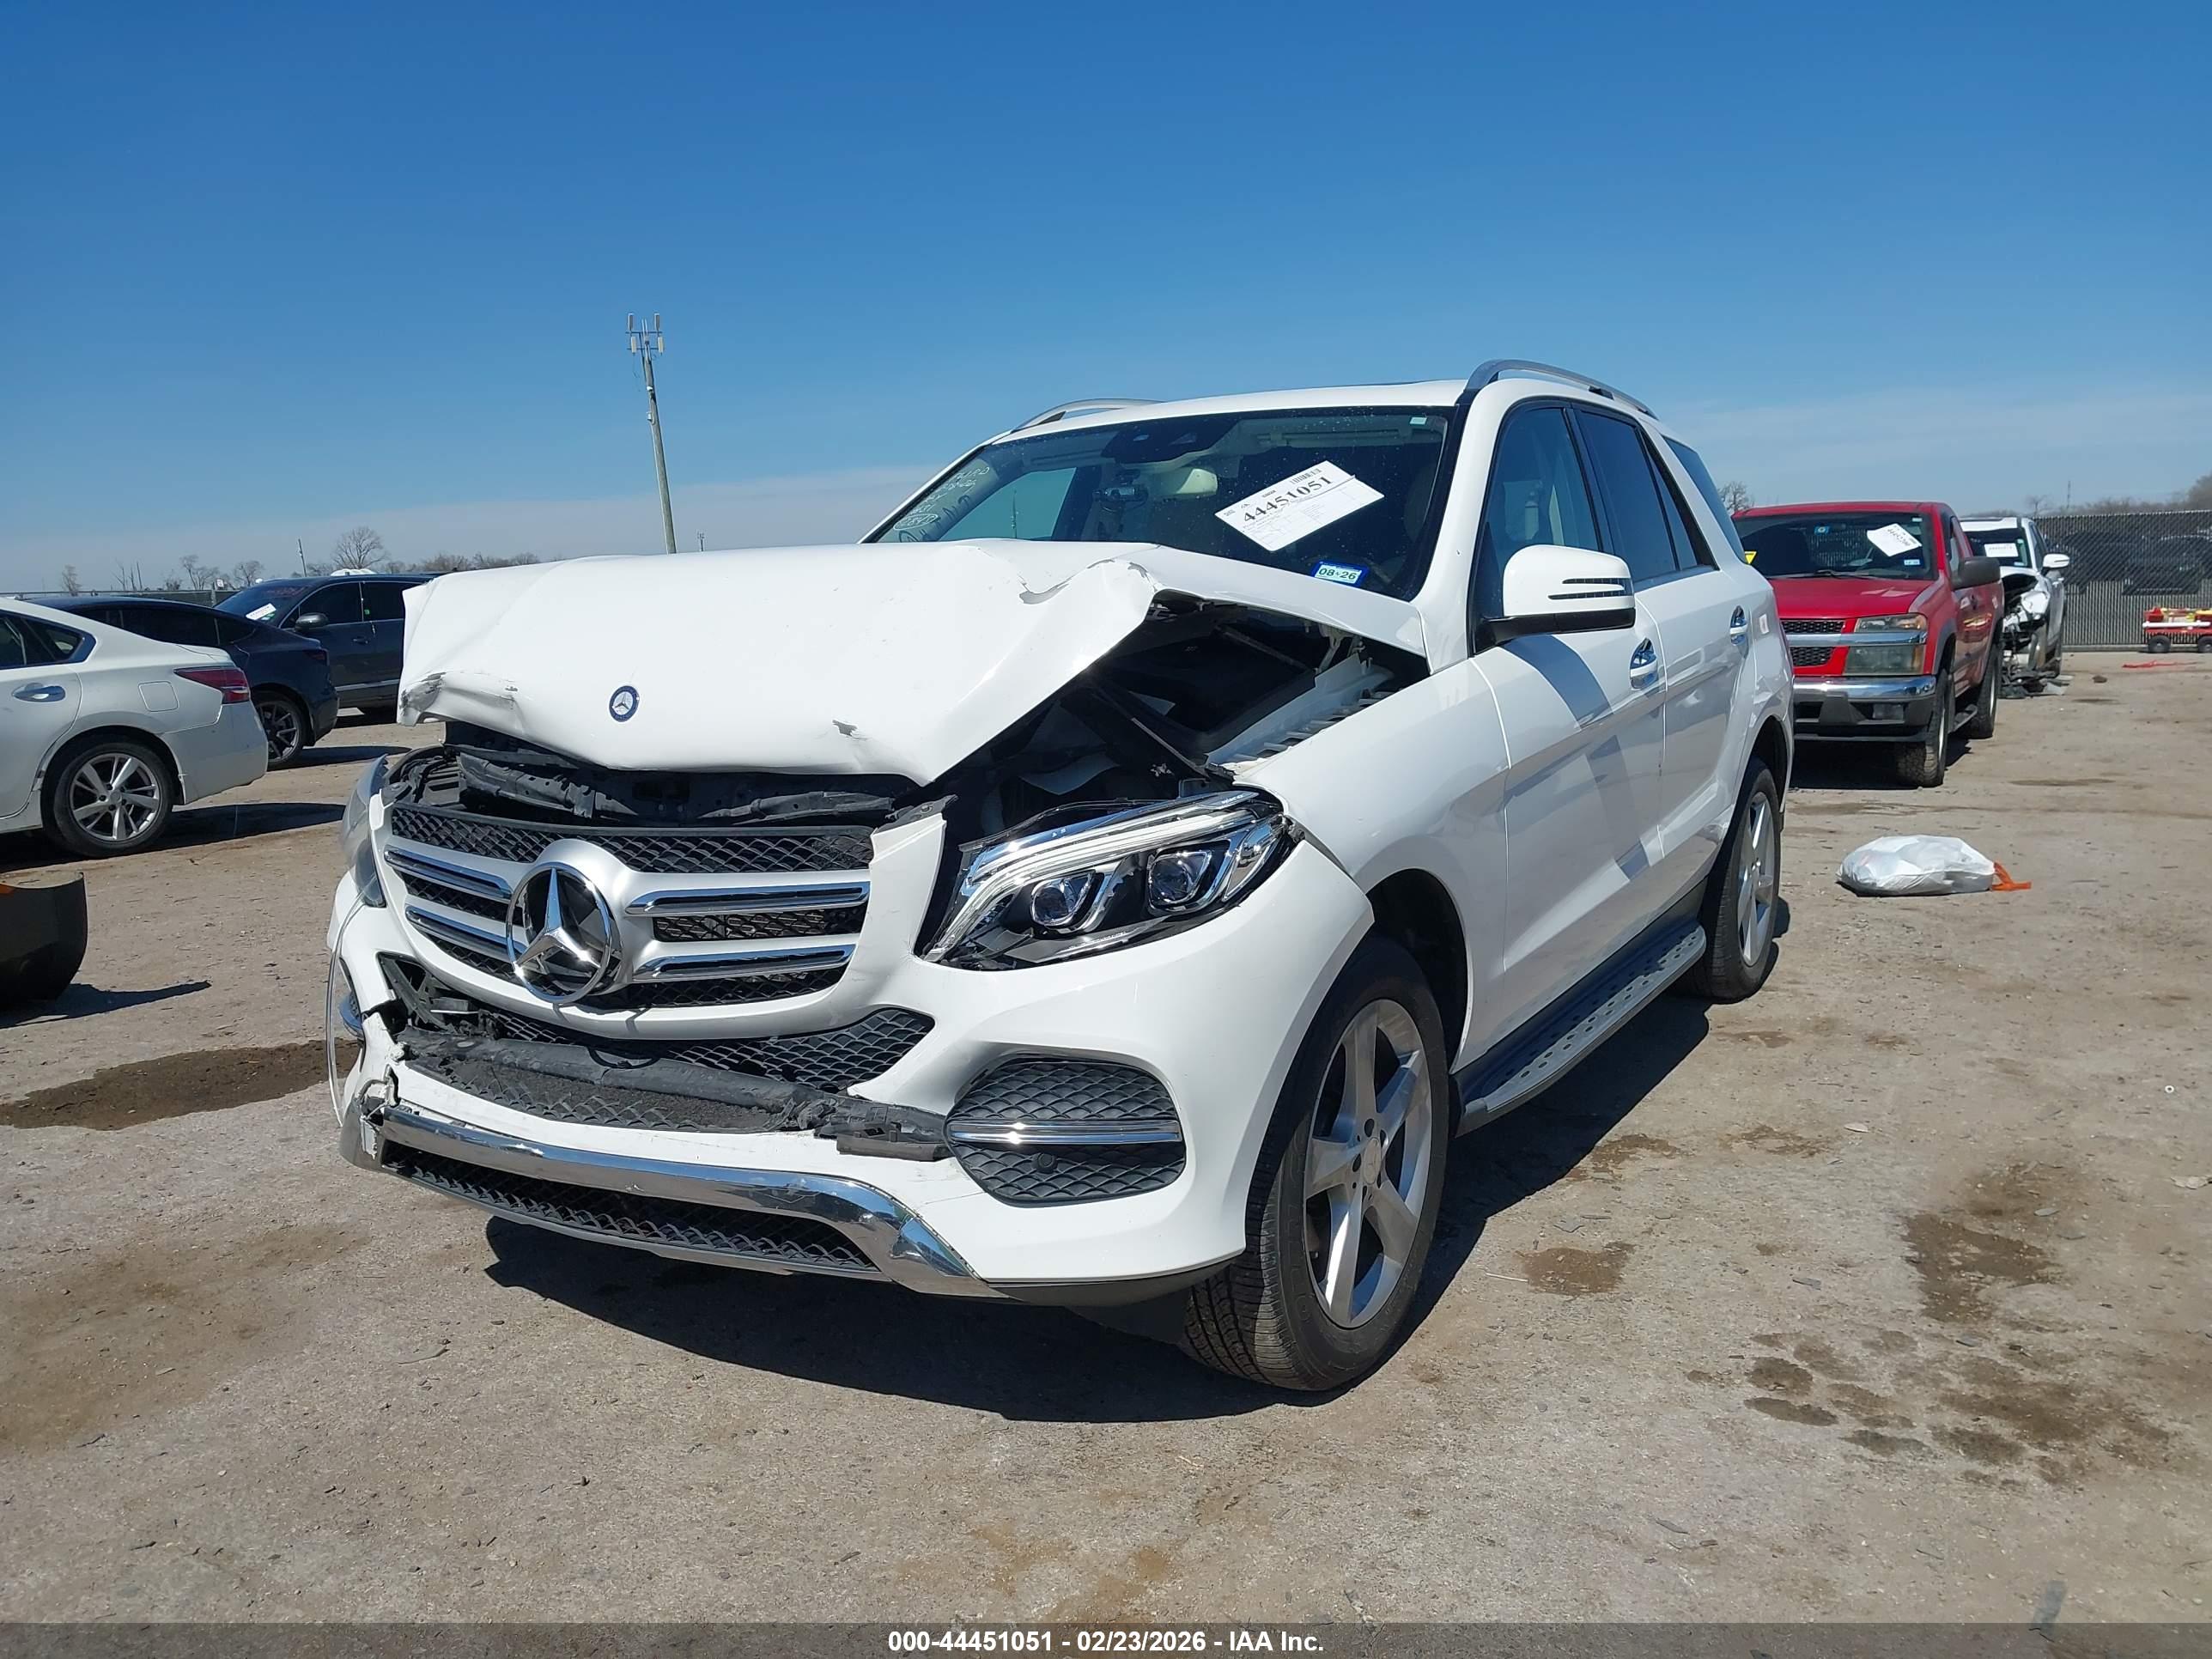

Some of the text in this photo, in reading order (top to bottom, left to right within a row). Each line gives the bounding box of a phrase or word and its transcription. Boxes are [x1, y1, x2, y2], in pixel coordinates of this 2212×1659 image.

[1243, 476, 1332, 522] 44451051
[1318, 568, 1358, 580] 08 26
